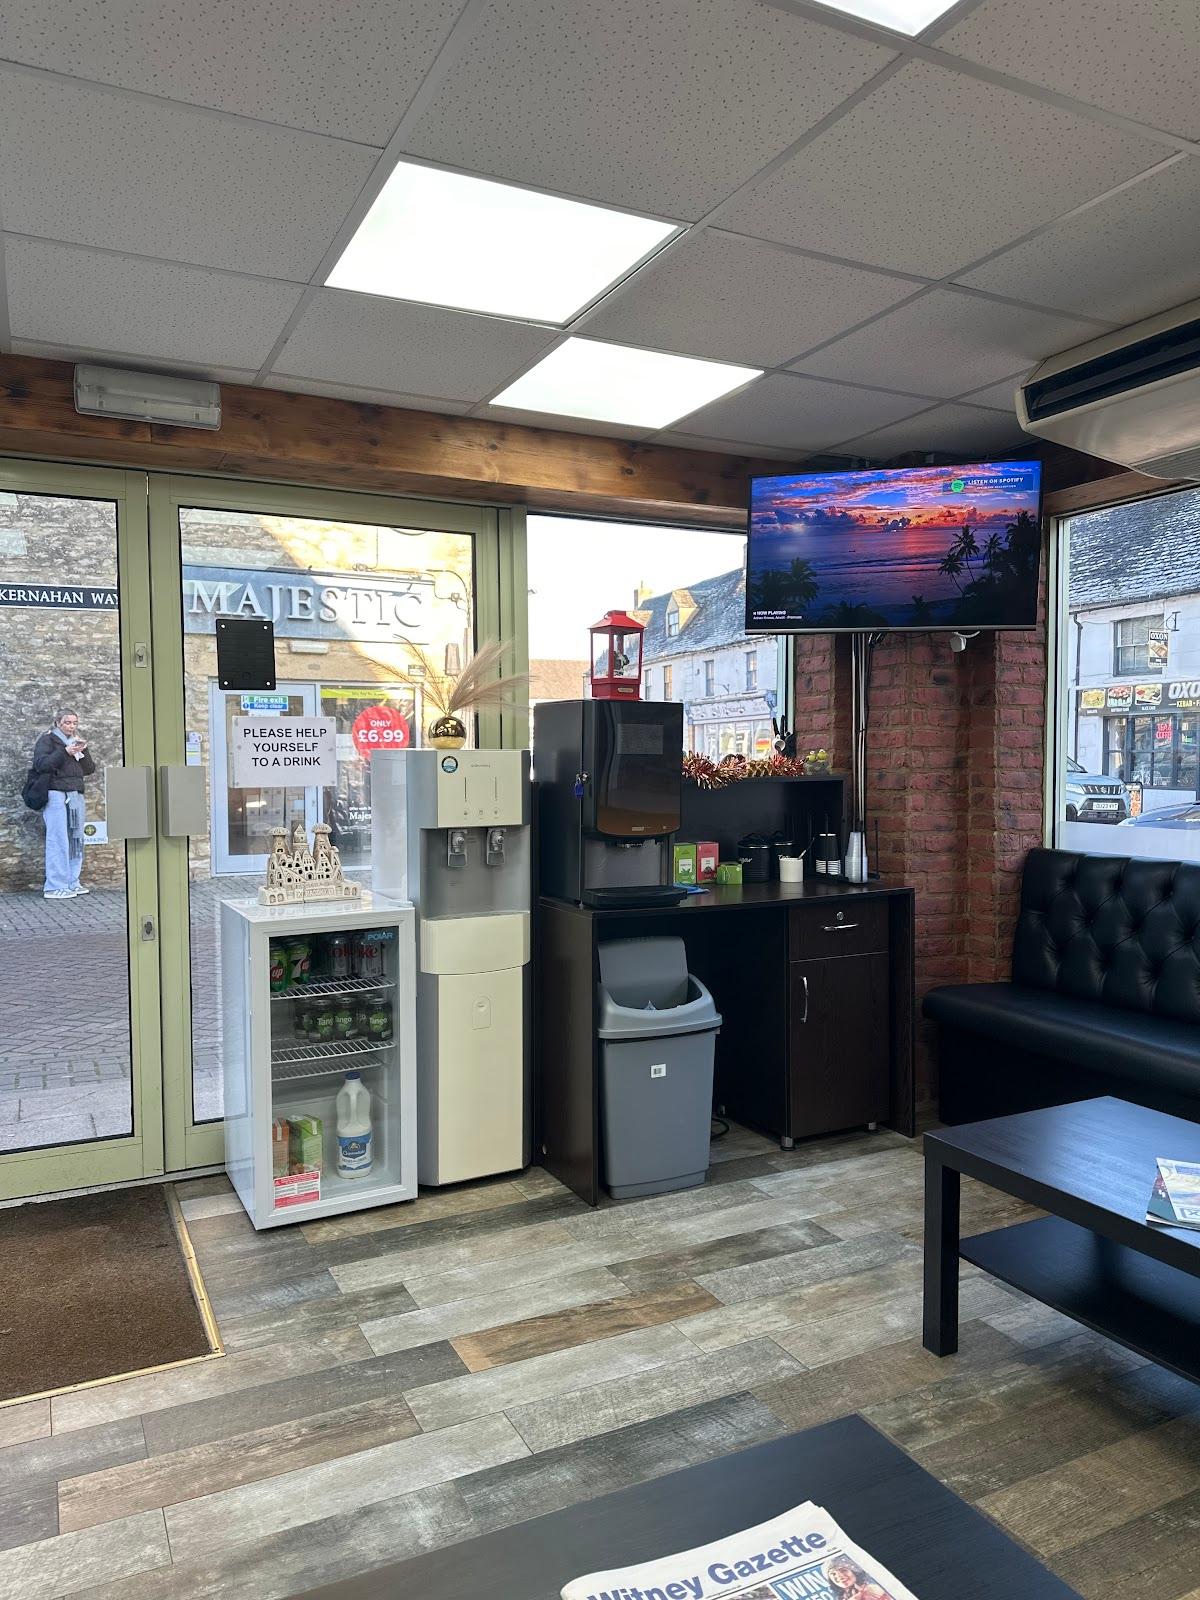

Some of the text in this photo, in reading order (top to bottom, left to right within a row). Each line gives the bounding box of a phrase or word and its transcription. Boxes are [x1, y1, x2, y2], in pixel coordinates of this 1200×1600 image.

[188, 581, 424, 628] MAJESTIC
[370, 719, 391, 727] ONLY
[243, 728, 327, 738] PLEASE HELP
[358, 729, 404, 743] £6.99
[253, 742, 319, 752] YOURSELF
[252, 756, 321, 767] TO A DRINK
[707, 1532, 827, 1585] Gazette
[775, 1569, 831, 1600] WIN
